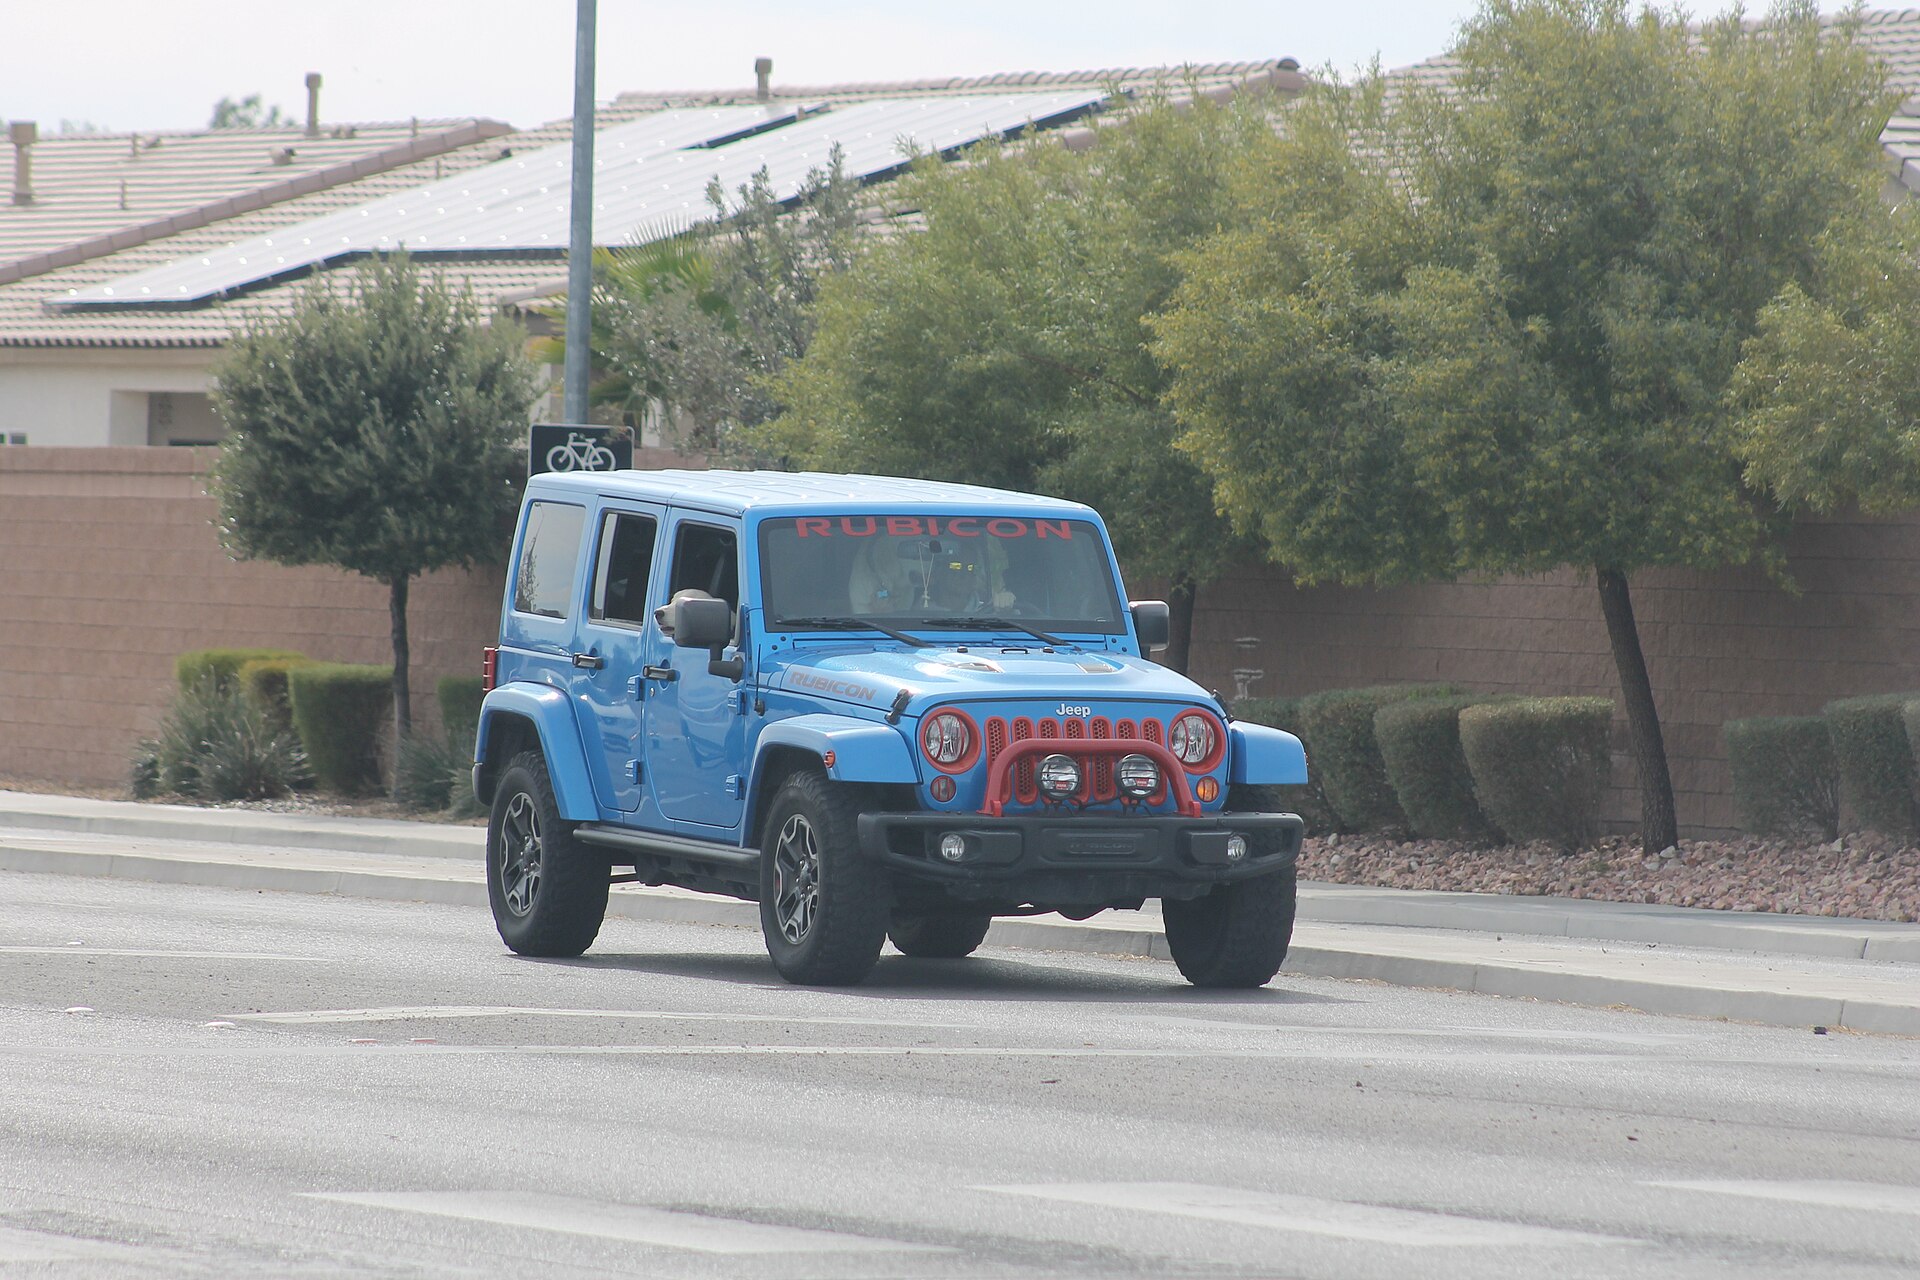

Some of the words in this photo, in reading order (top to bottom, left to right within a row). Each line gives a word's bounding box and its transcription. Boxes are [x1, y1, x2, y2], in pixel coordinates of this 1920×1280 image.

[795, 517, 1073, 540] RUBICON
[789, 671, 877, 701] RUBICON
[1055, 703, 1091, 718] Jeep
